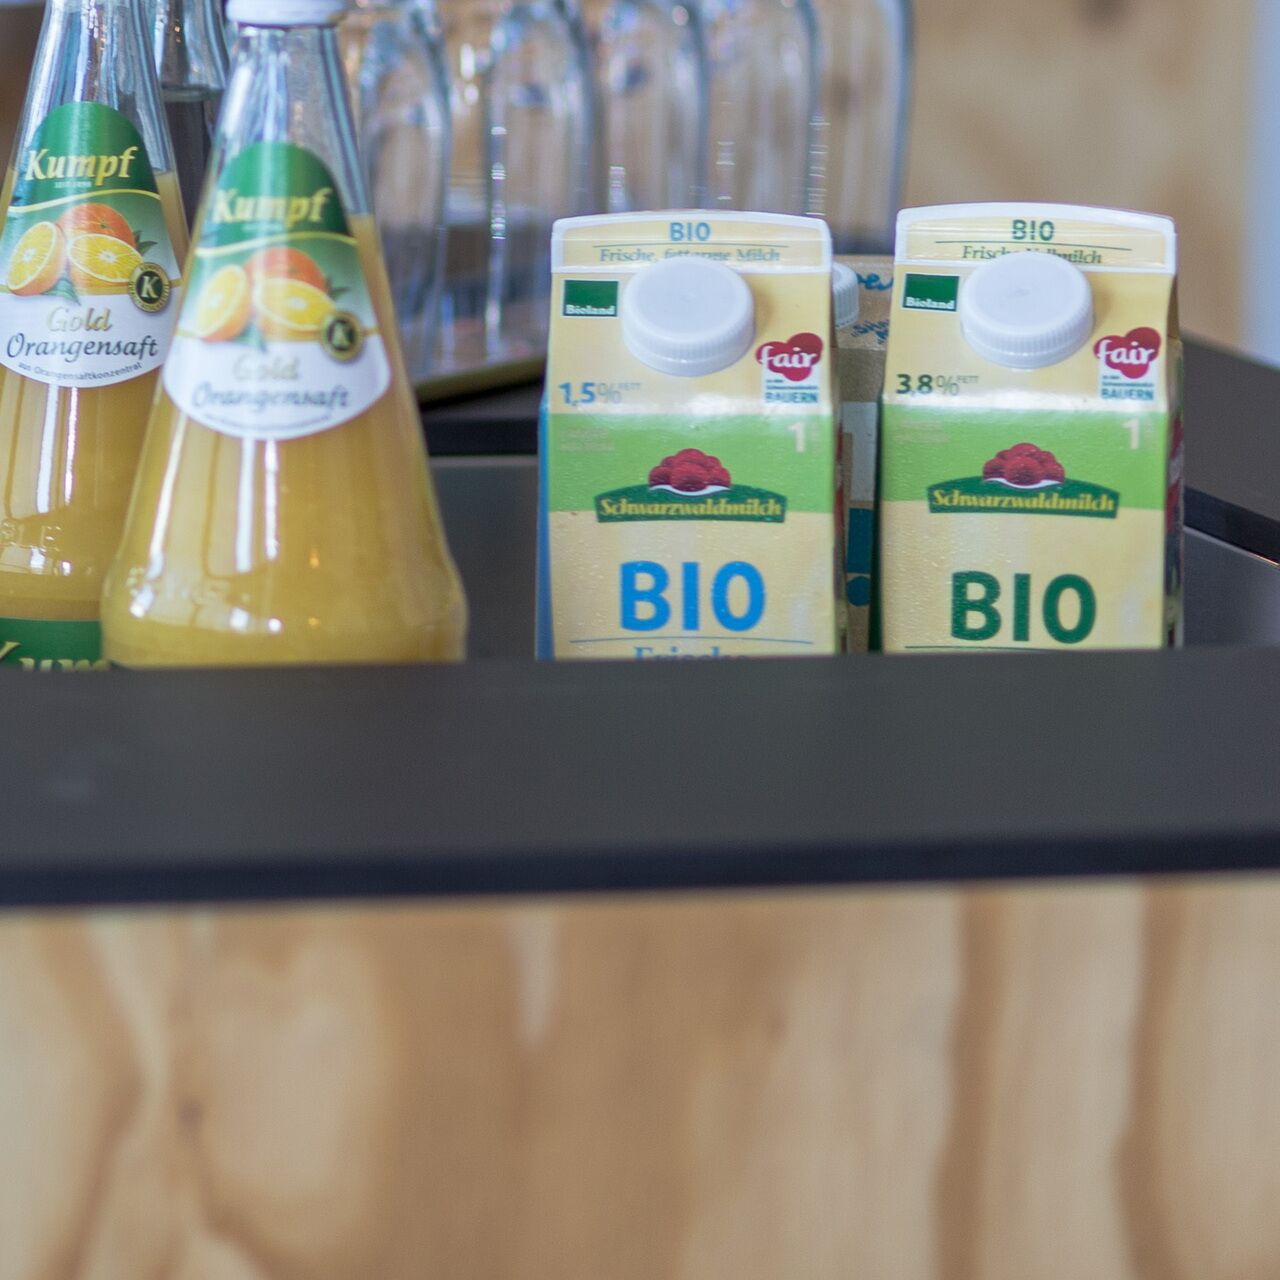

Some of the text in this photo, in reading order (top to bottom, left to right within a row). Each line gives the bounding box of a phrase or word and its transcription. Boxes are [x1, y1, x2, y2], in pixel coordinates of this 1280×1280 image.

[25, 146, 138, 187] Kumpf
[212, 187, 333, 229] Kumpf
[670, 222, 711, 241] BIO
[1012, 219, 1055, 241] BIO
[736, 248, 780, 262] Milch
[141, 275, 160, 298] K
[566, 304, 615, 316] Bioland
[906, 296, 955, 310] Bioland
[48, 306, 112, 333] Gold
[6, 332, 159, 363] Orangensaft
[759, 345, 818, 369] fair
[1097, 339, 1155, 366] fair
[192, 382, 348, 413] Orangensaft
[601, 498, 782, 516] Schwarzwaldmilch
[933, 489, 1114, 511] Schwarzwaldmilch
[620, 560, 766, 632] BIO
[951, 570, 1096, 644] BIO
